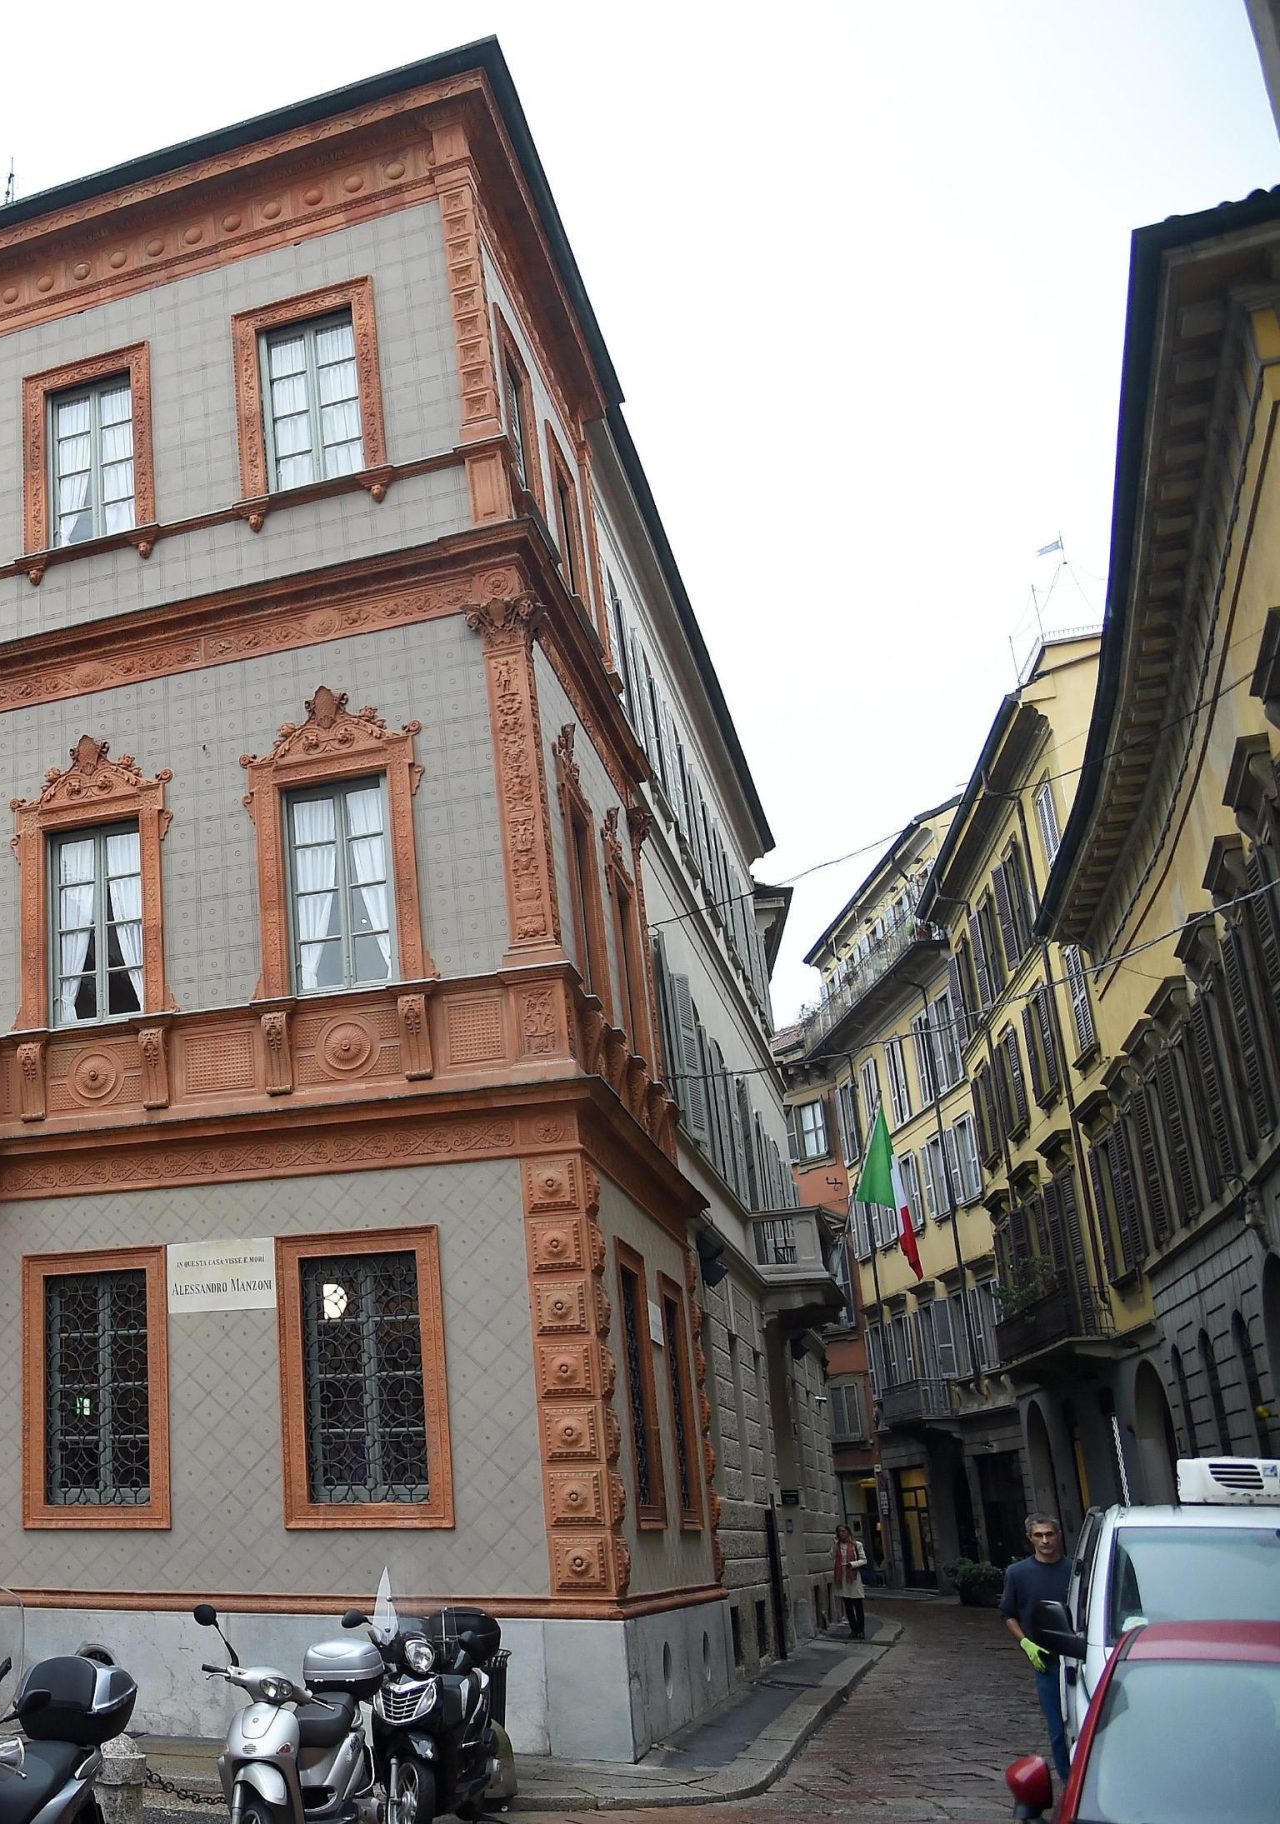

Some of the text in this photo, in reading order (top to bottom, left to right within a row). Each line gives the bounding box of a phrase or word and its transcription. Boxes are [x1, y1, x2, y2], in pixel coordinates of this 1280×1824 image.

[176, 1261, 183, 1269] IN
[184, 1260, 207, 1268] QUESTA
[208, 1258, 224, 1266] CASA
[225, 1257, 242, 1265] VISSE
[171, 1278, 272, 1296] ALESSANDRO MANZONI
